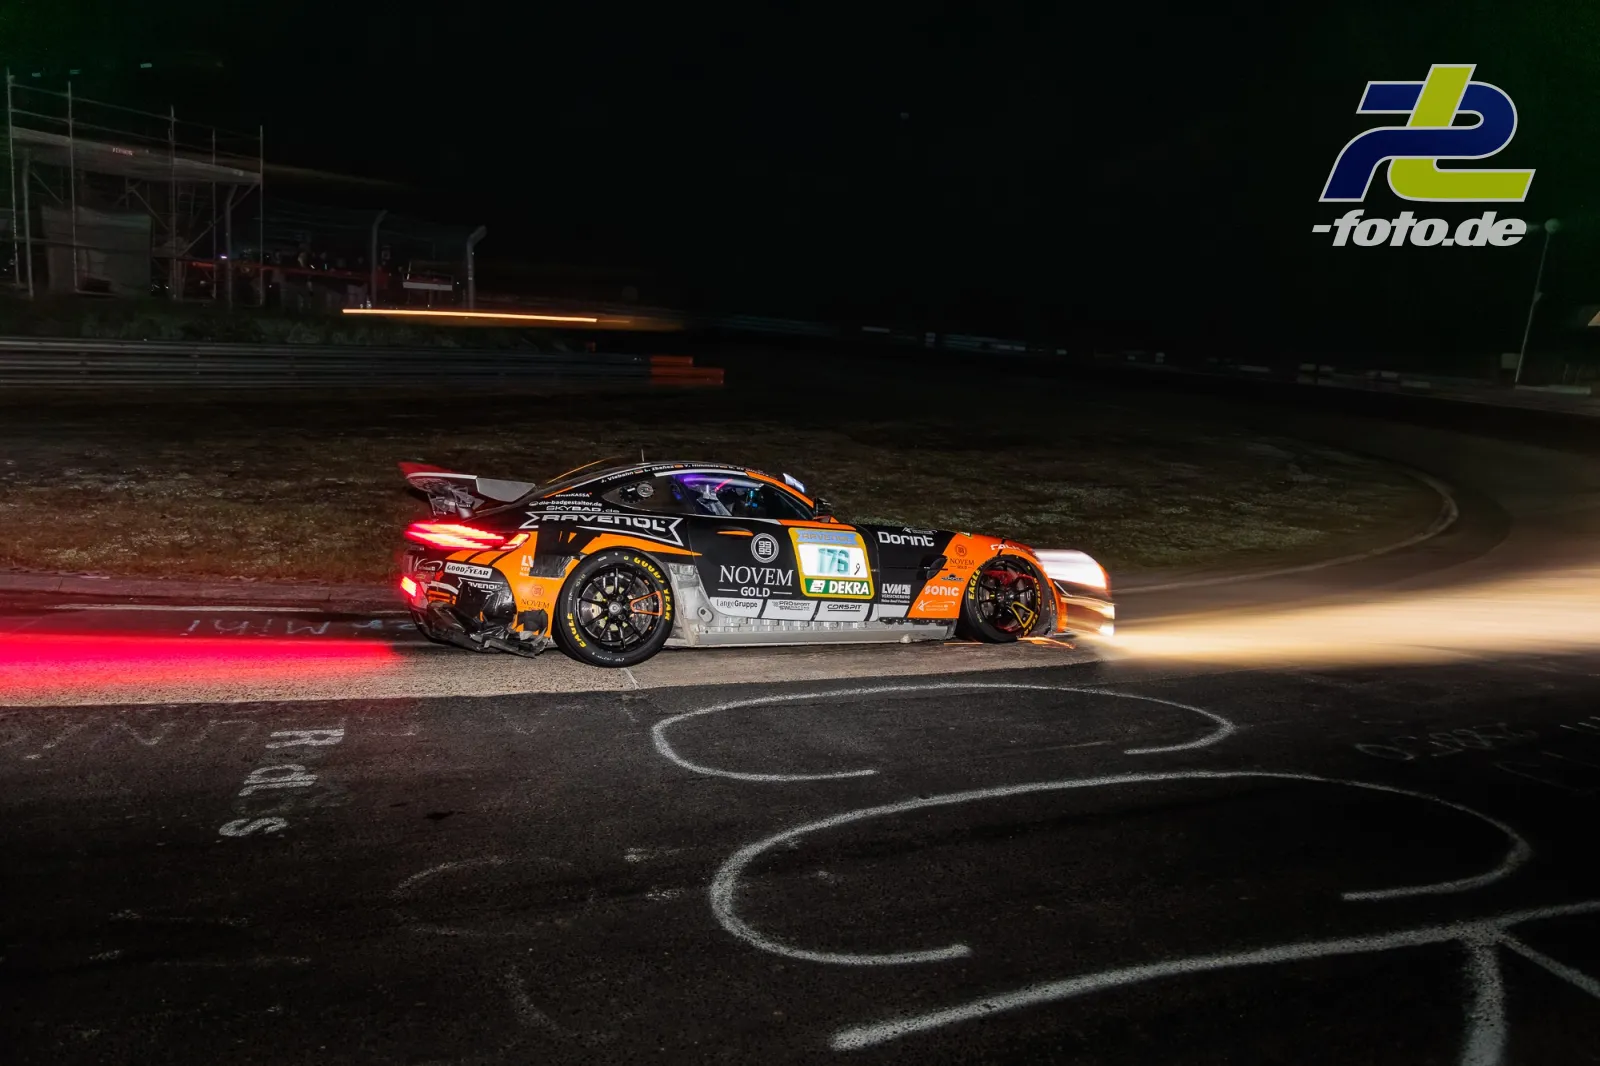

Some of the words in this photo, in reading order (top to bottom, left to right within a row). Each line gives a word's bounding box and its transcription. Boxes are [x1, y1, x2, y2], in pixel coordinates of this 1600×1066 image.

[541, 514, 666, 532] RAVENOL
[877, 531, 935, 547] Dorint
[949, 558, 975, 566] NOVEM
[719, 565, 794, 587] NOVEM
[740, 586, 771, 597] GOLD
[828, 580, 870, 595] DEKRA
[881, 583, 903, 595] LVM
[967, 569, 981, 600] EAGLE
[521, 598, 550, 609] NOVEM
